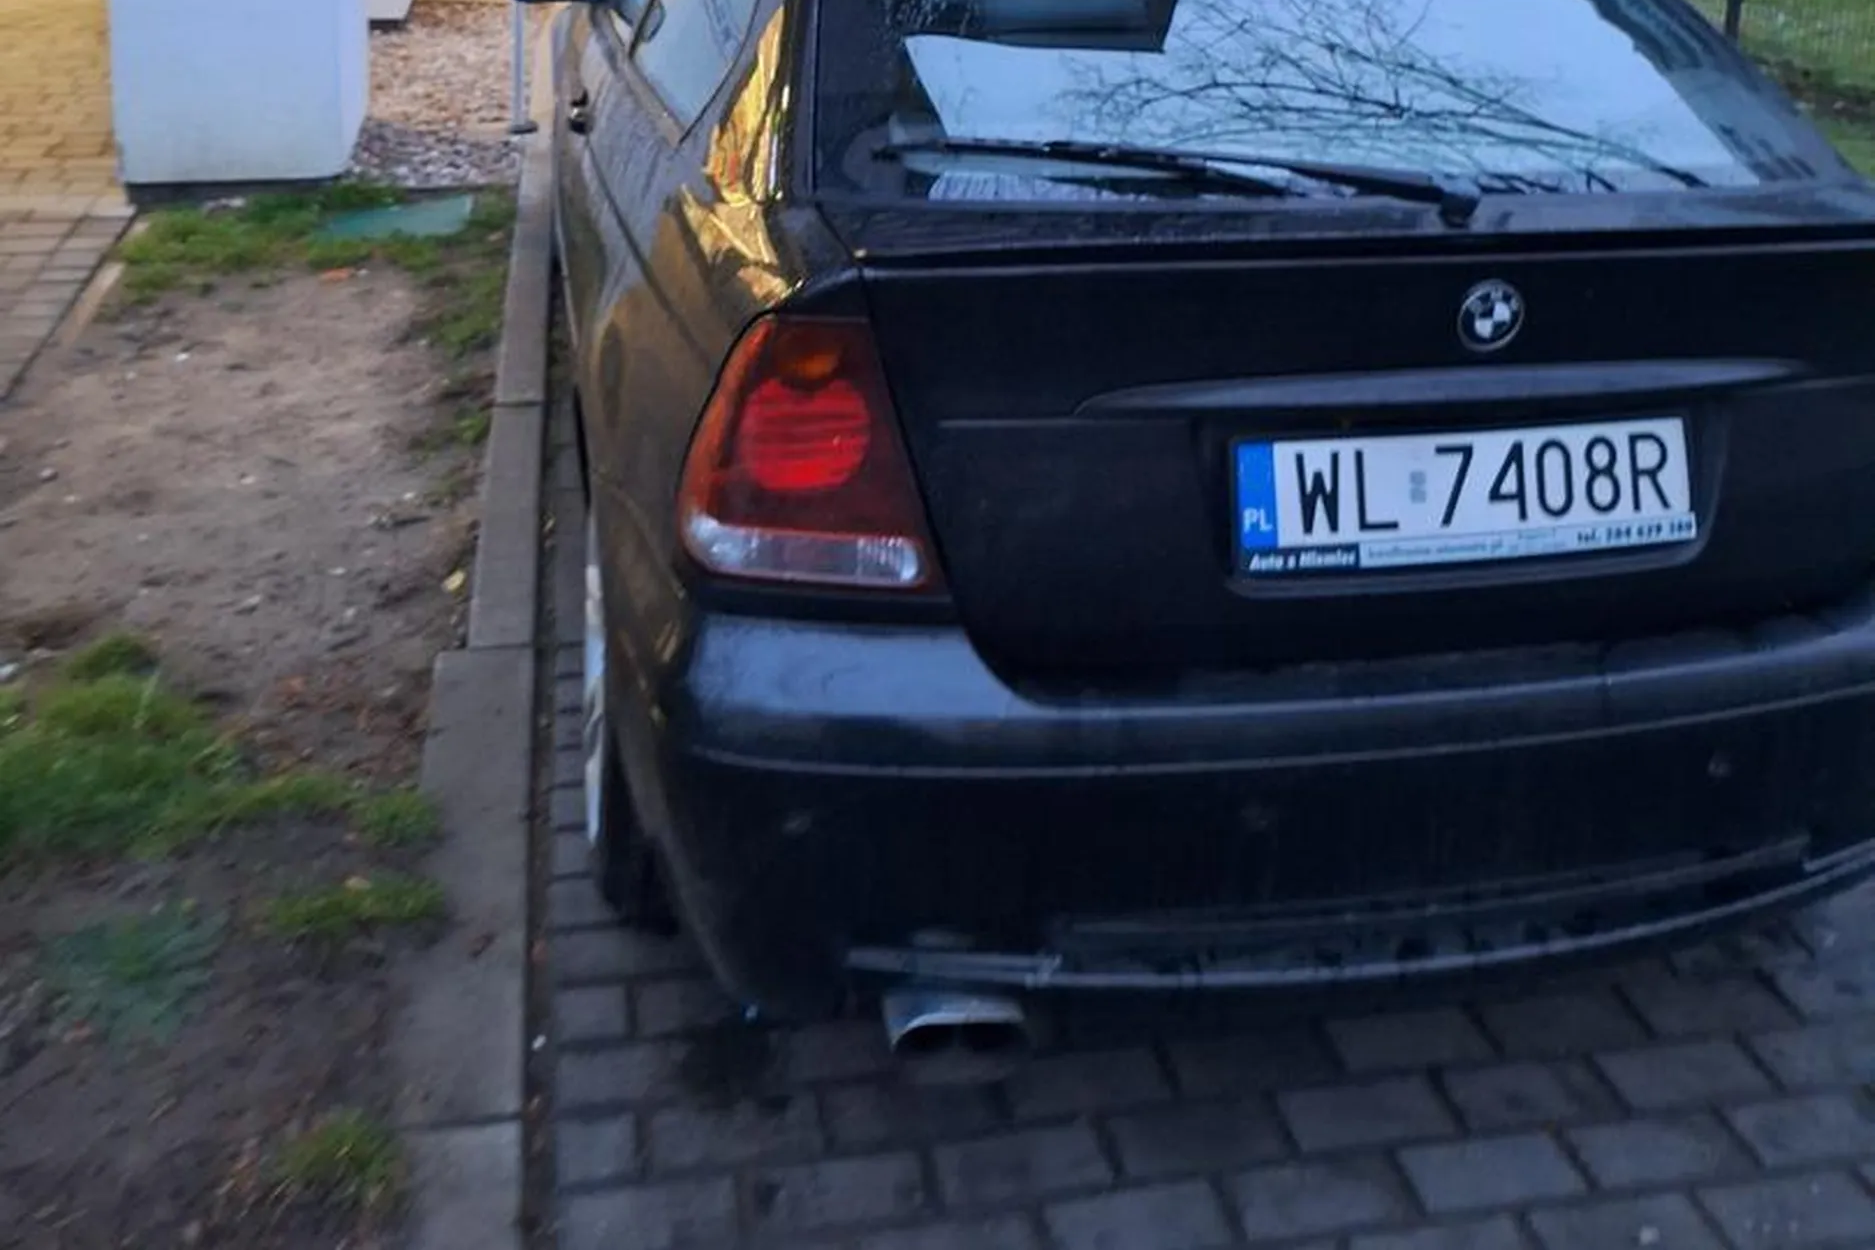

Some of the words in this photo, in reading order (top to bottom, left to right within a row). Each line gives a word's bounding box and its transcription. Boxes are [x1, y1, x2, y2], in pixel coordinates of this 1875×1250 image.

[1295, 449, 1399, 535] WL
[1434, 432, 1671, 528] 7408R
[1243, 507, 1273, 534] PL
